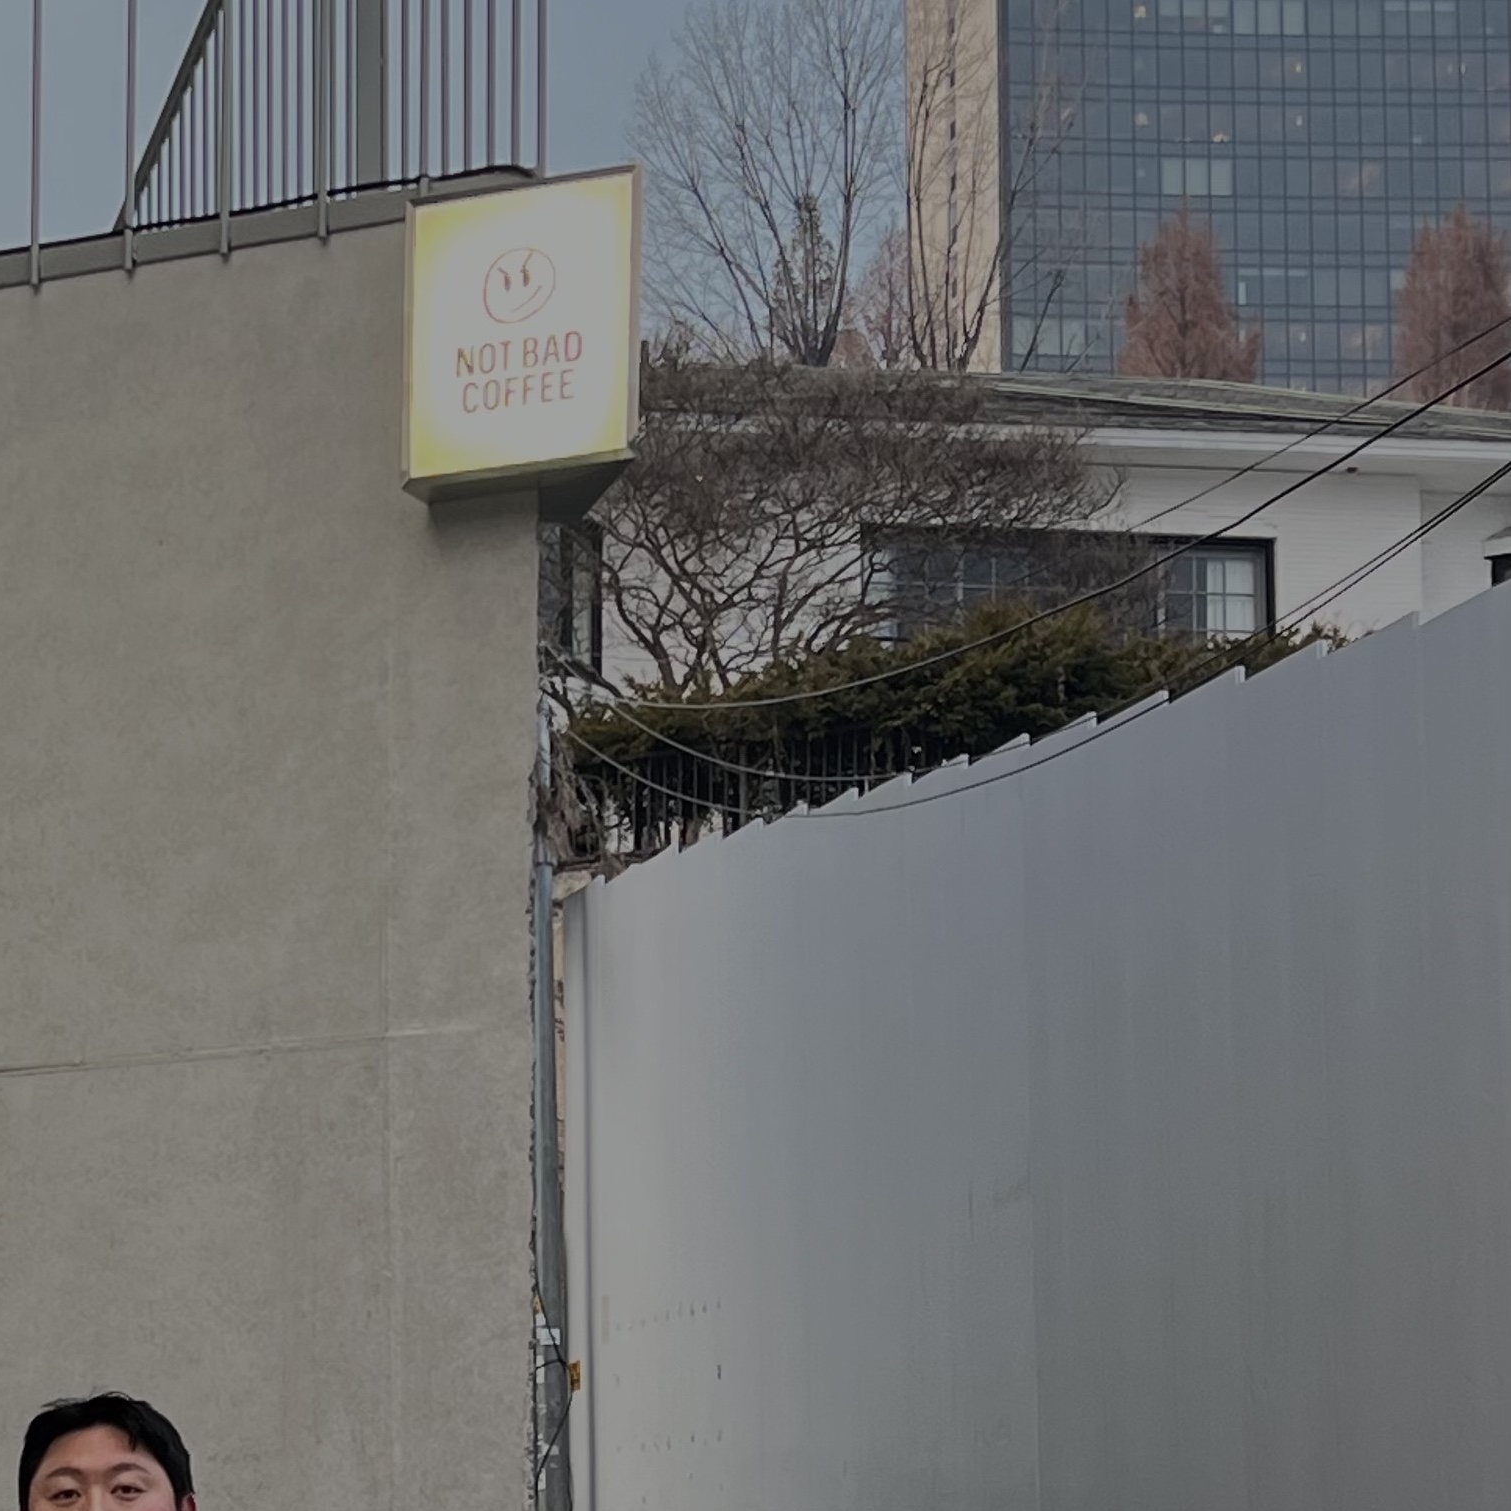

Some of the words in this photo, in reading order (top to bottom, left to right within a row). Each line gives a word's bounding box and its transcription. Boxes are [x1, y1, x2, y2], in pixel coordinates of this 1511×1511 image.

[456, 341, 512, 377] NOT
[523, 331, 582, 368] BAD
[463, 369, 574, 414] COFFEE
